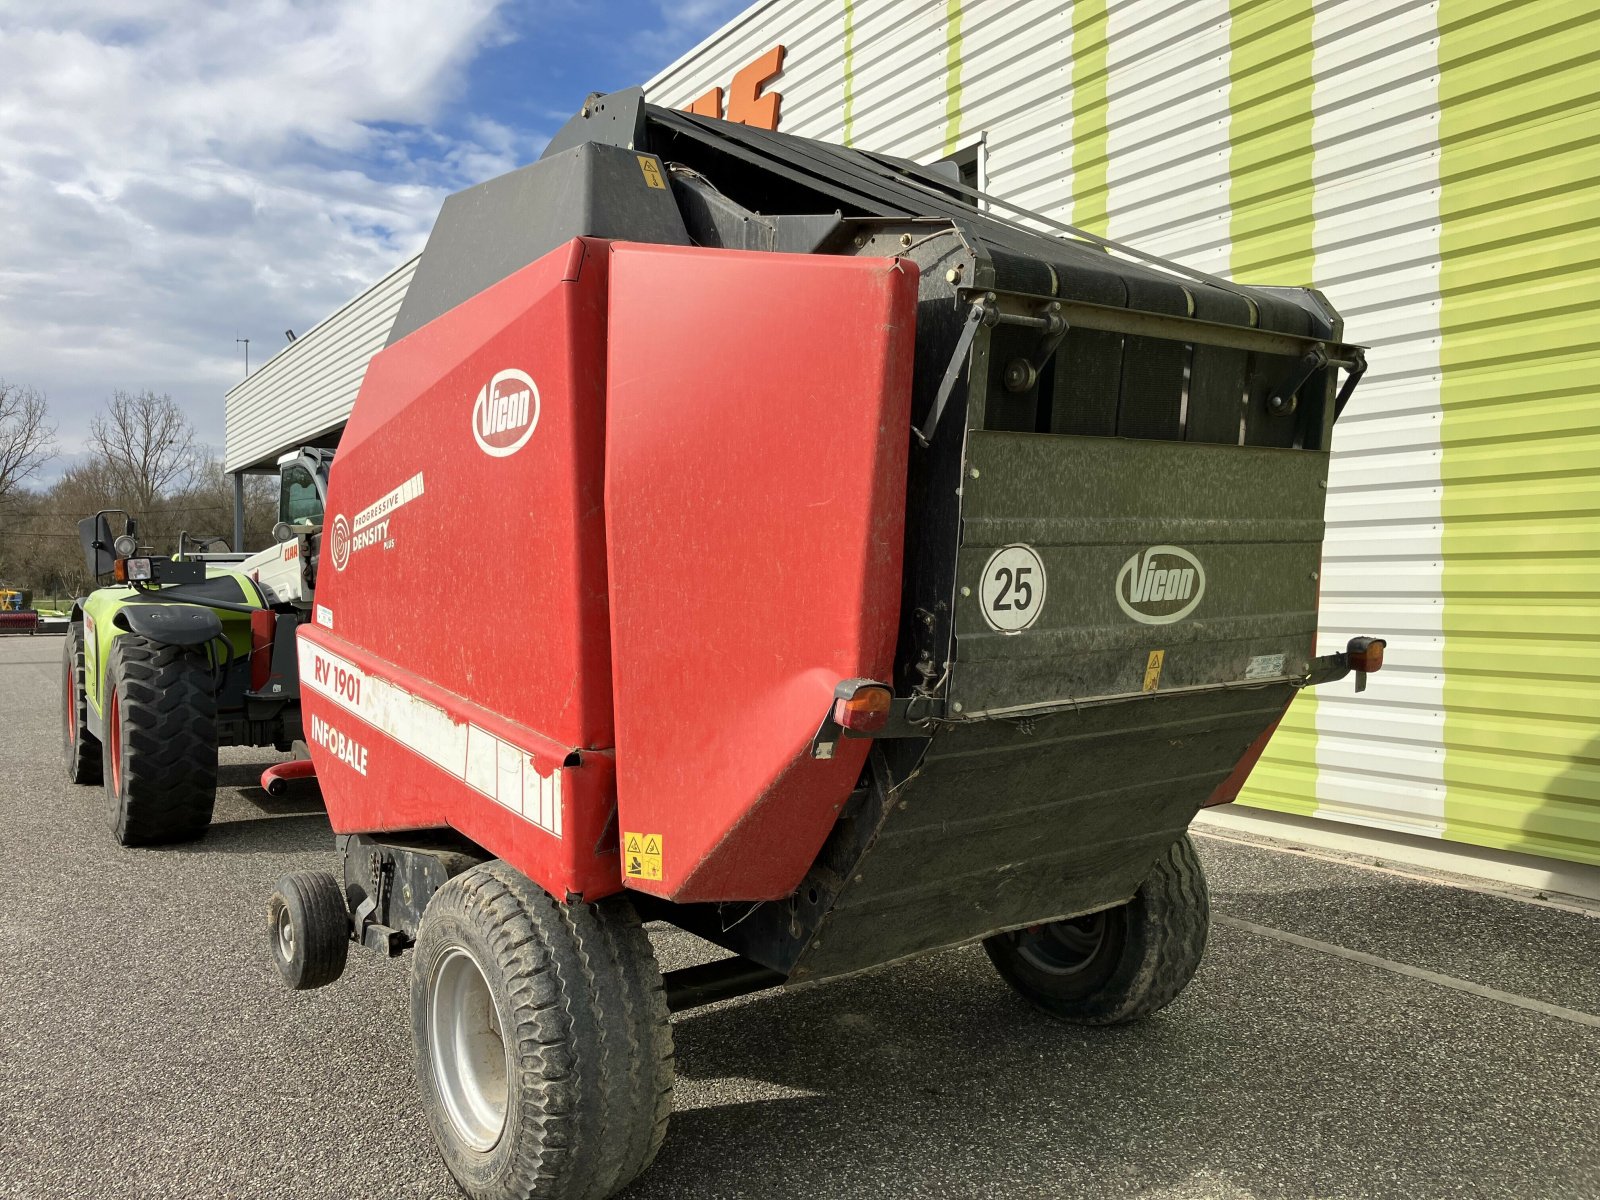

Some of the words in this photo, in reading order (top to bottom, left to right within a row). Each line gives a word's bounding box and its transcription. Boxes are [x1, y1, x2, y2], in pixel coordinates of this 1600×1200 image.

[479, 379, 532, 438] Vicon
[352, 518, 390, 552] DENSITY
[354, 492, 399, 529] PROGRESSIVE
[993, 567, 1032, 611] 25
[1128, 551, 1196, 605] Vicon
[315, 655, 331, 686] RV
[334, 666, 361, 706] 1901
[311, 713, 368, 777] INFOBALE
